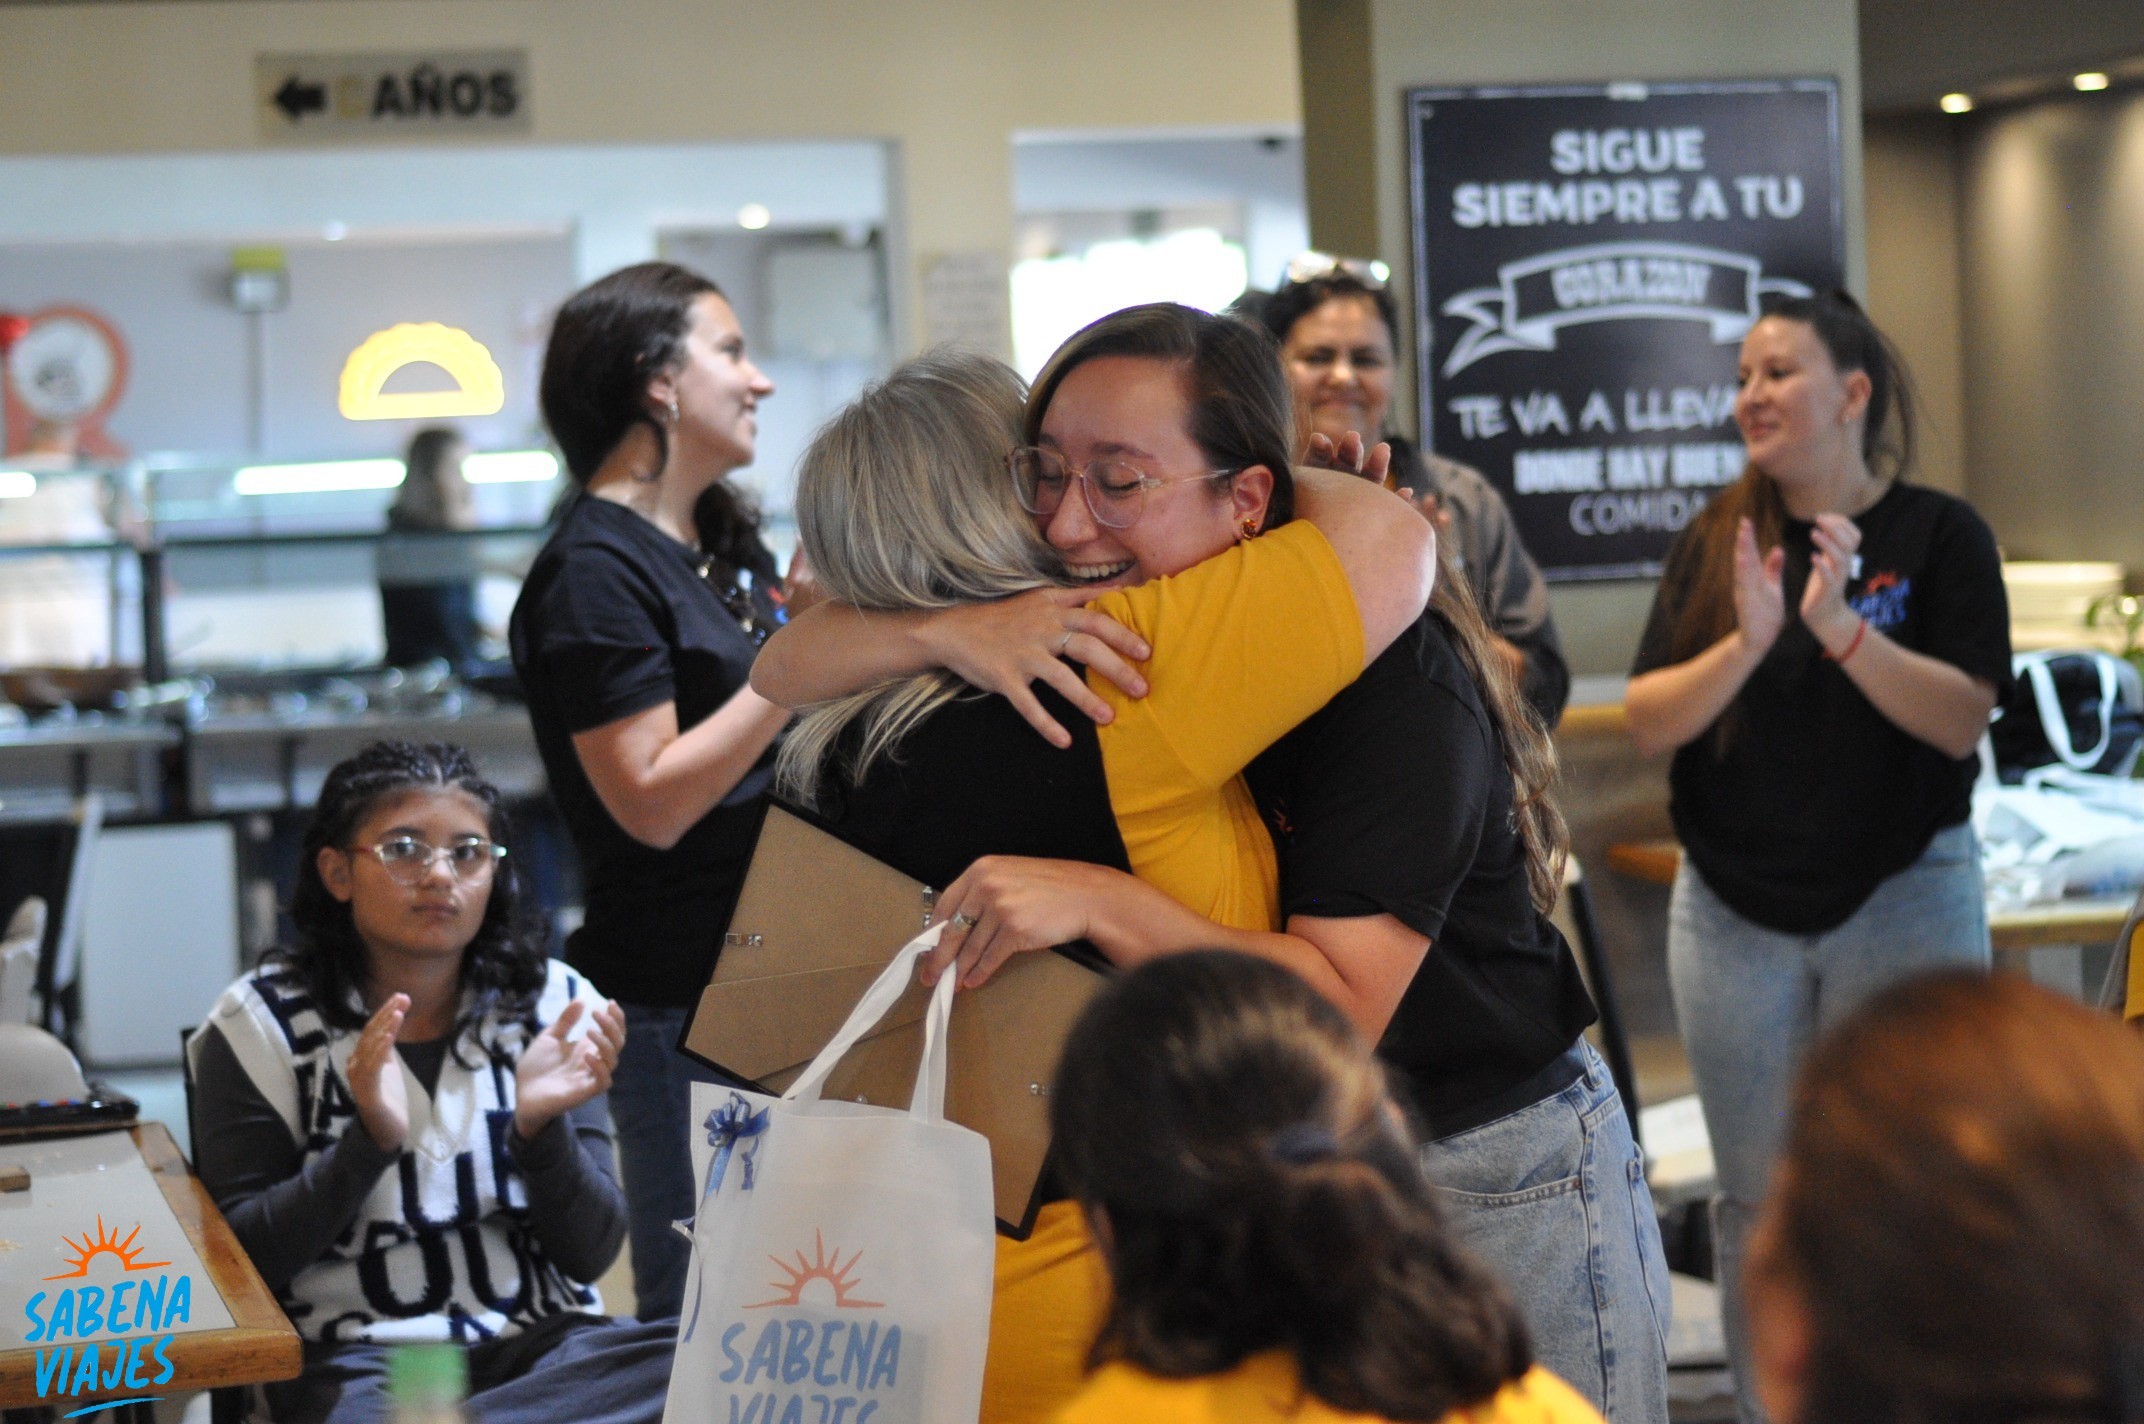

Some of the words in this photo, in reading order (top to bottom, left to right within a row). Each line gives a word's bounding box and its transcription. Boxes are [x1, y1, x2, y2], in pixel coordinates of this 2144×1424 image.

[1550, 127, 1706, 175] SIGUE
[1452, 178, 1682, 228] SIEMPRE
[1690, 178, 1729, 222] A
[1733, 175, 1804, 220] TU
[1448, 394, 1508, 440] TE
[1510, 387, 1571, 437] VA
[1579, 389, 1617, 434] A
[1624, 384, 1738, 434] LLEVA
[719, 1319, 902, 1391] SABENA
